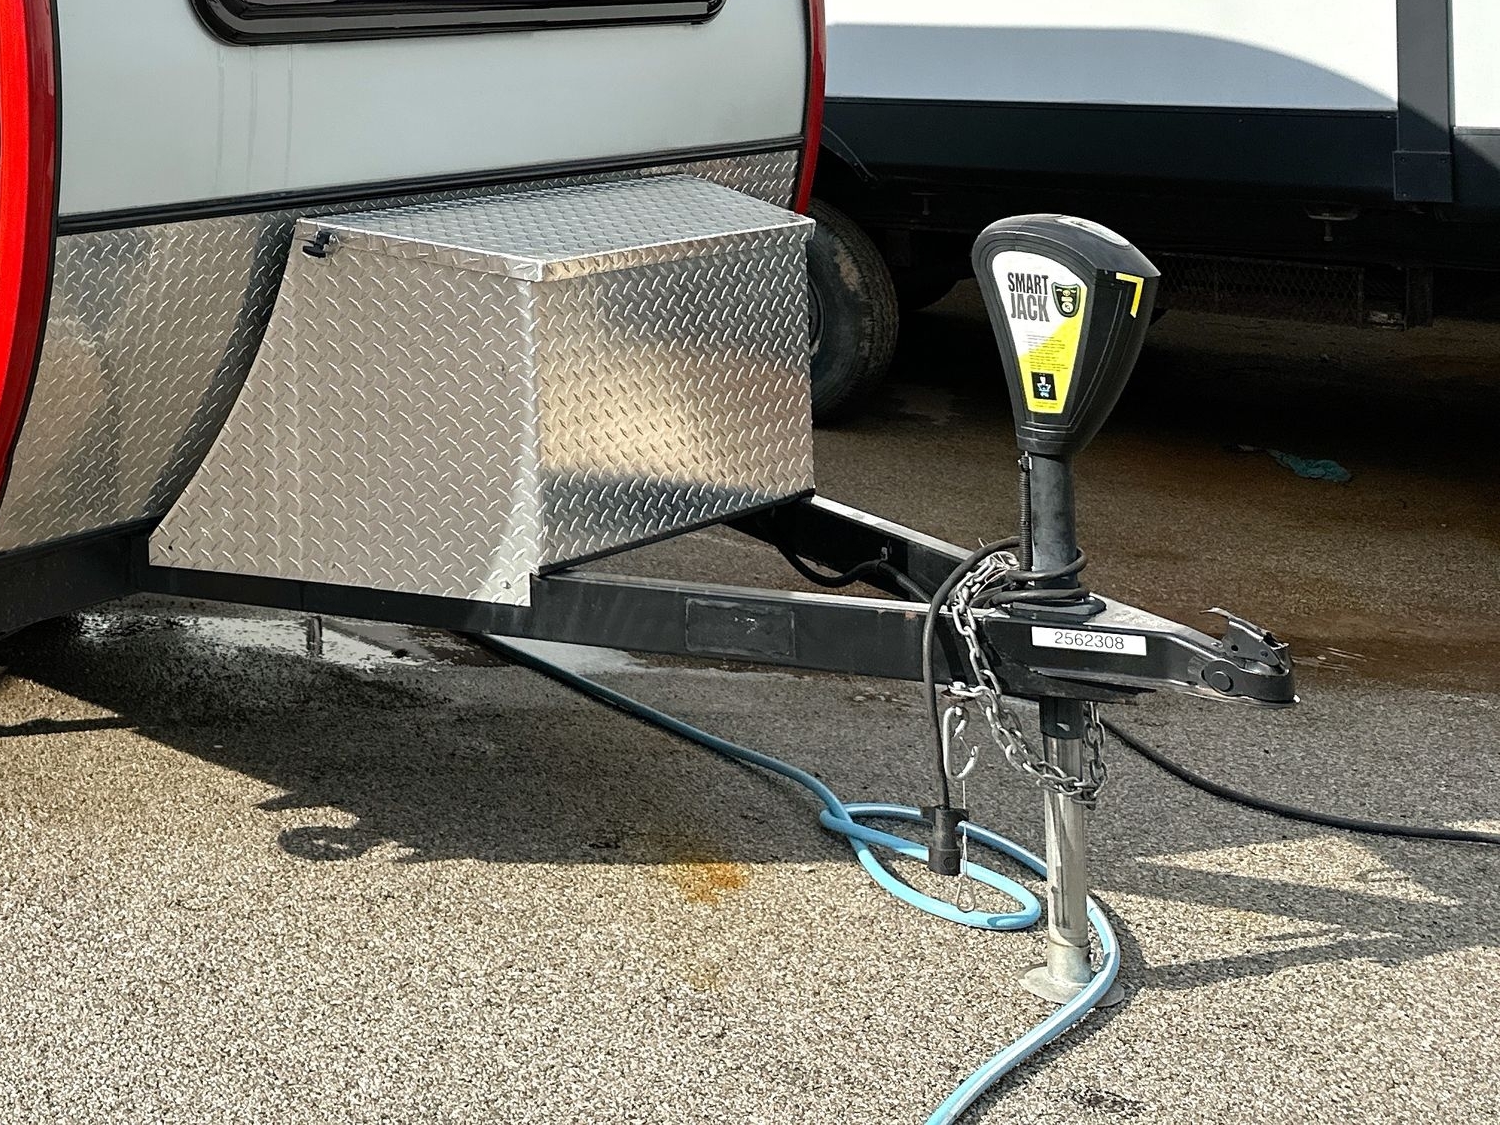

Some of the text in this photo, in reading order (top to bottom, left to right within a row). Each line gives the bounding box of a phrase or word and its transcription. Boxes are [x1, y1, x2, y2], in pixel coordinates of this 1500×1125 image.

[1007, 272, 1049, 295] SMART
[1010, 293, 1050, 322] JACK
[1054, 631, 1125, 650] 2562308
